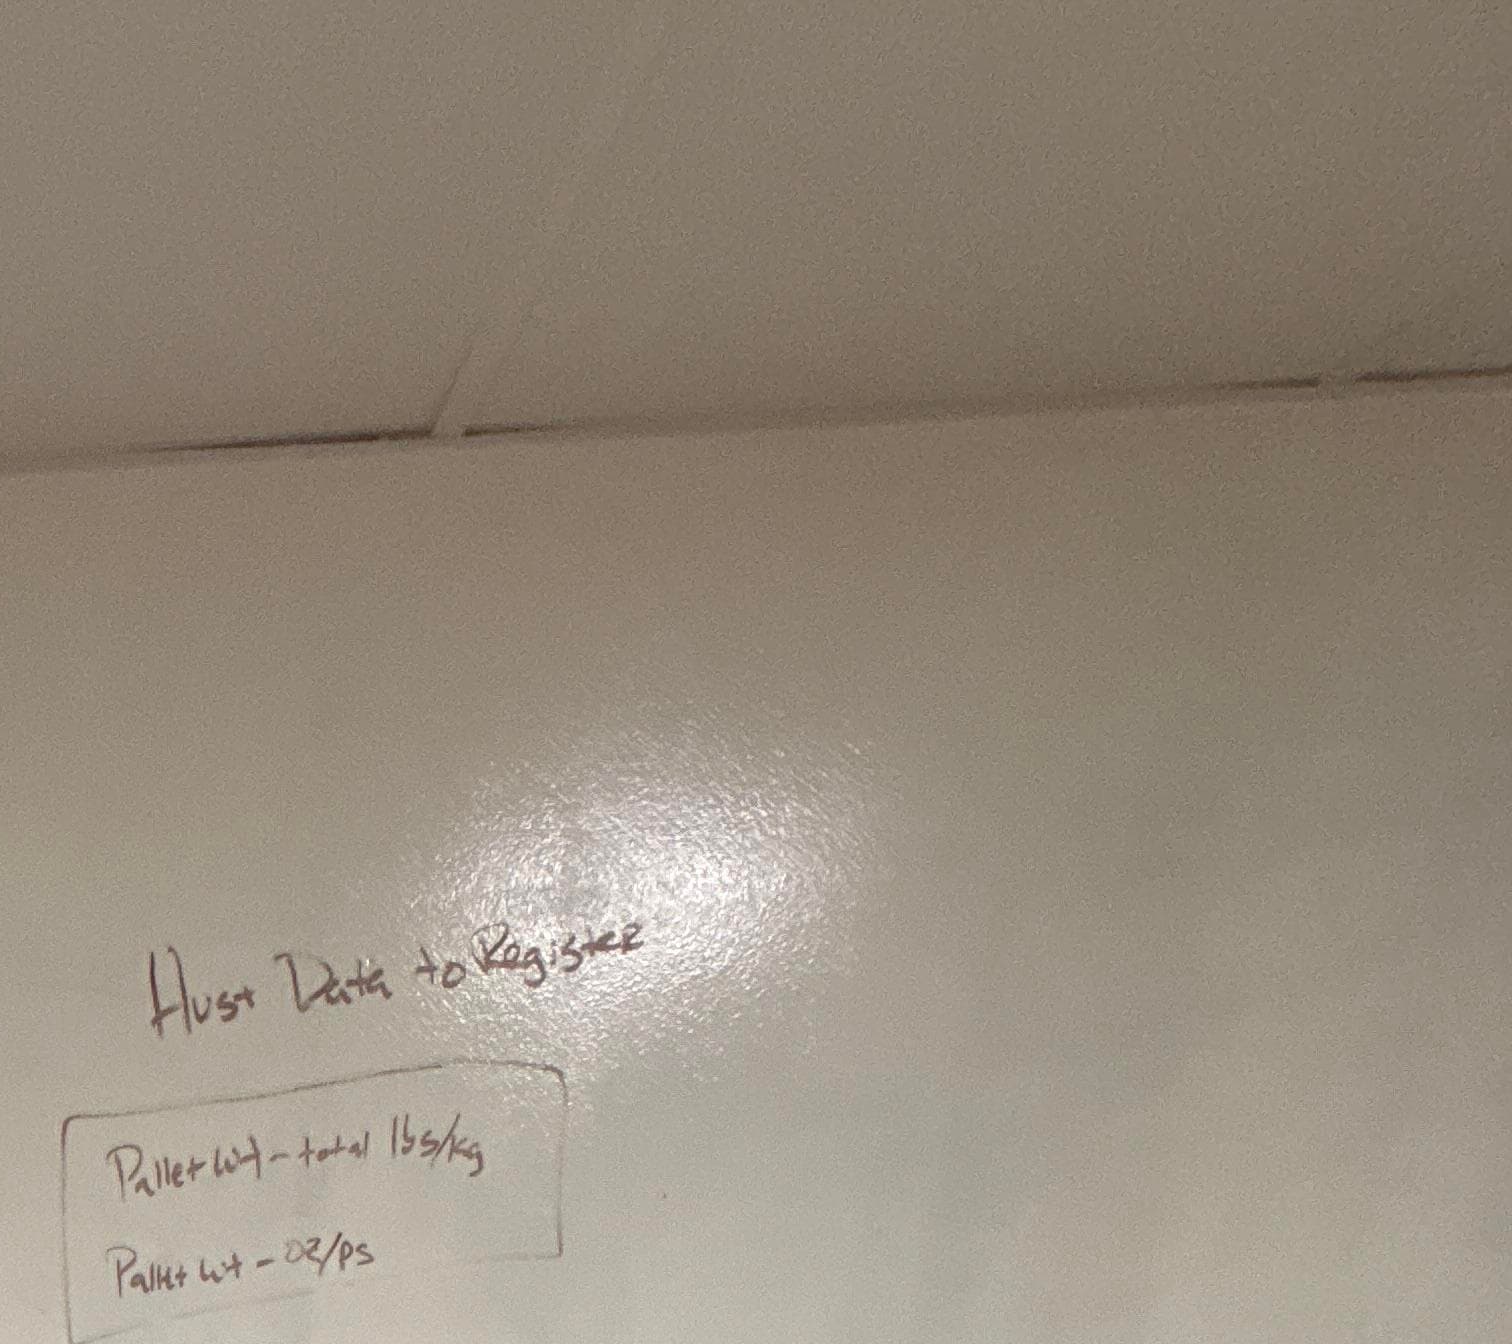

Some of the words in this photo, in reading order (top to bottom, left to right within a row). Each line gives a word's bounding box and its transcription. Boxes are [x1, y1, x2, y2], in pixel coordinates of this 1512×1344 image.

[274, 952, 393, 1012] Data
[415, 946, 466, 990] to
[106, 1144, 205, 1201] Pallet
[298, 1132, 370, 1170] total
